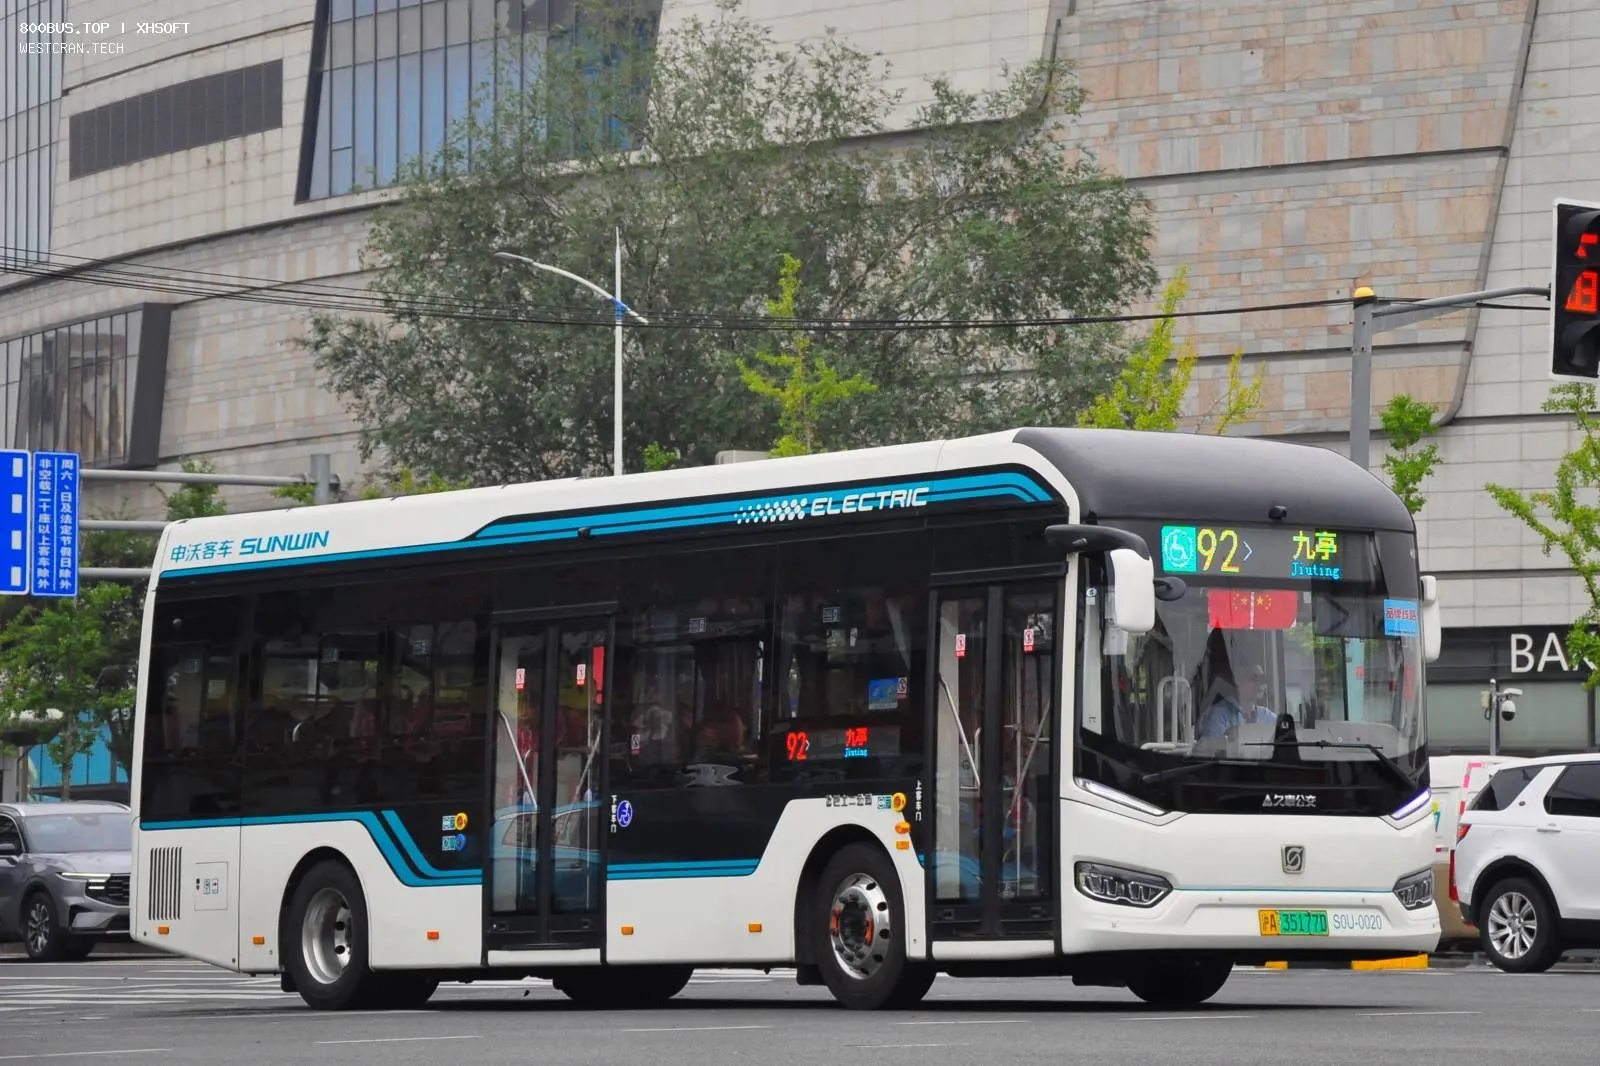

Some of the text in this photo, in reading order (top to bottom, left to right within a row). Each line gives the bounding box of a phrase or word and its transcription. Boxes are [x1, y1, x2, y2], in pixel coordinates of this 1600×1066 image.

[810, 487, 930, 516] ELECTRIC
[170, 530, 330, 562] 申沃客车 SUNWIN
[1197, 528, 1240, 573] 92
[1292, 530, 1338, 561] 九亭
[1290, 561, 1341, 580] Jiuting
[786, 731, 807, 760] 92
